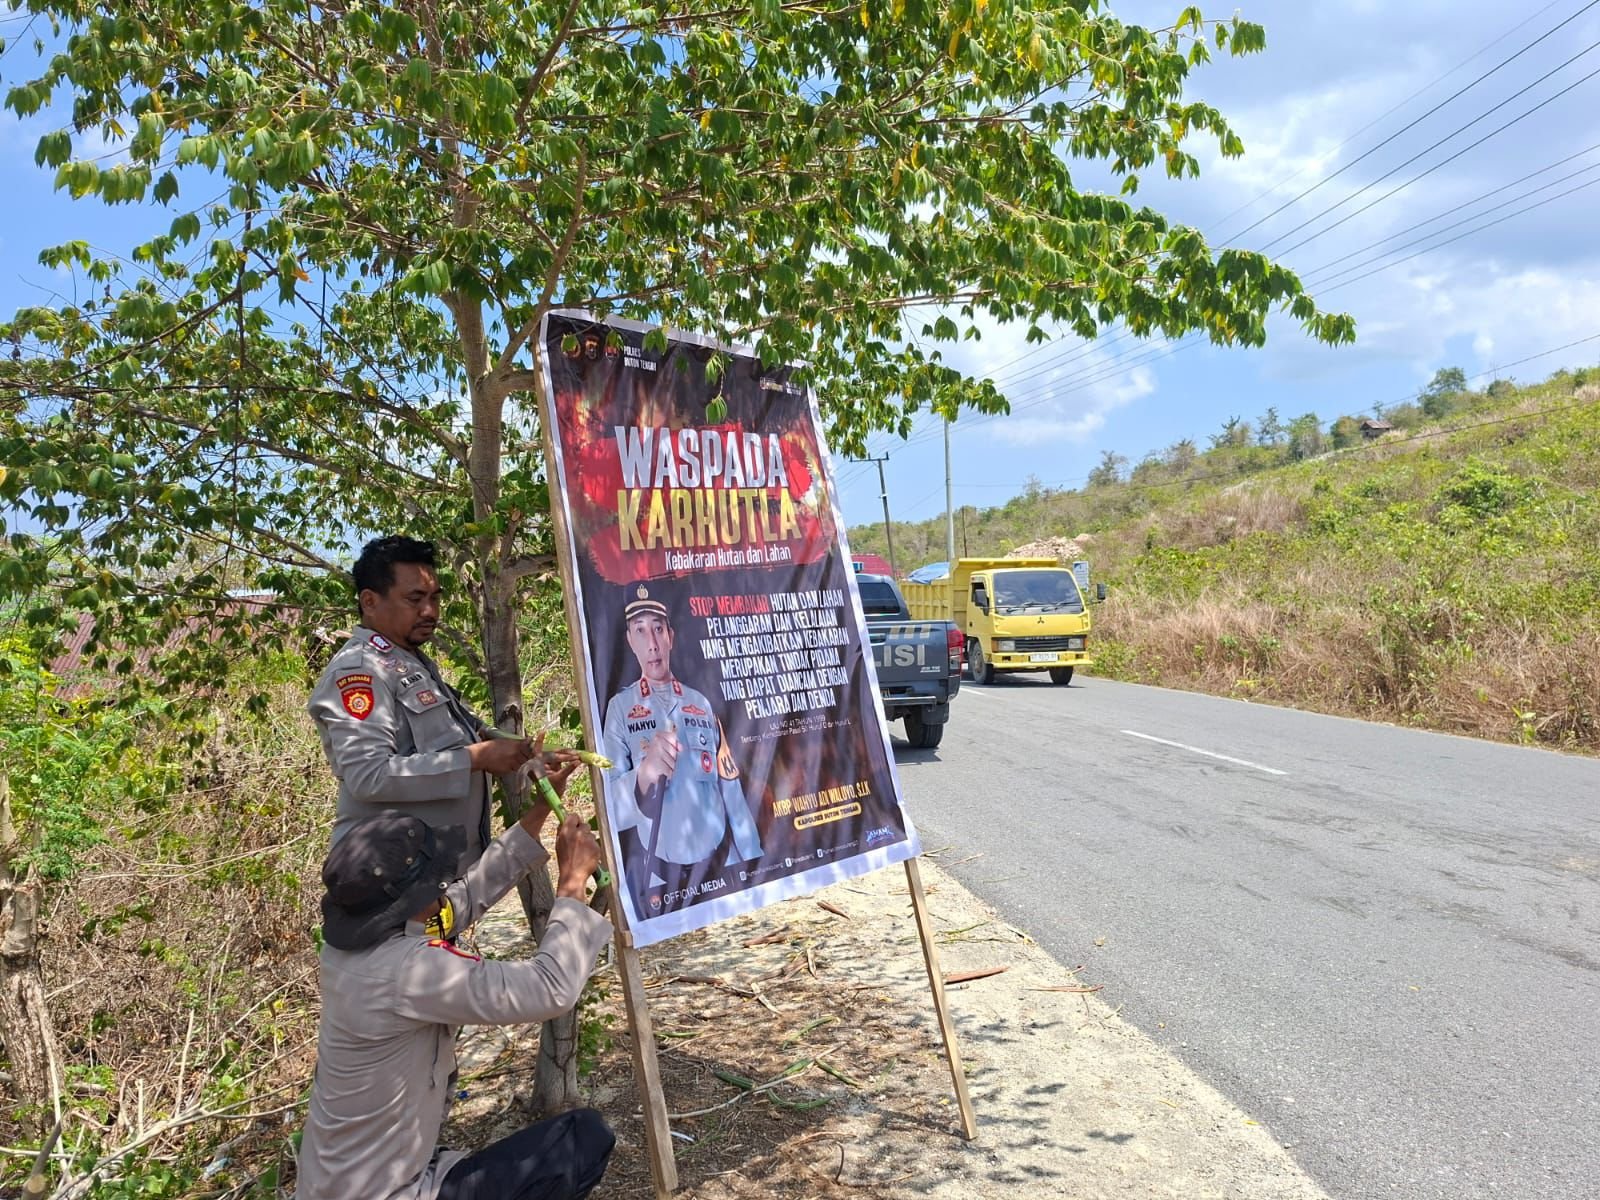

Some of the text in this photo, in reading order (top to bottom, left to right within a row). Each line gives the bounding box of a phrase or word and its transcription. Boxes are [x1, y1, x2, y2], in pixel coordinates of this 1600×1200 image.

[614, 426, 789, 488] WASPADA
[617, 488, 802, 550] KARHUTLA
[665, 544, 791, 571] Kebakaran Hutan dan Lahan
[689, 589, 844, 616] STOP MEMBAKAR HUTAN DAN LAHAN
[706, 608, 838, 637] PELANGGARAN DAN KELALAIAN
[700, 627, 850, 659] YANG MENGAKIBATKAN KEBAKARAN
[720, 647, 840, 679] MERUPAKAN TINDAK PIDANA
[720, 666, 848, 701] YANG DAPAT DIANCAM DENGAN
[745, 688, 836, 719] PENJARA DAN DENDA
[628, 719, 656, 734] WAHYU
[684, 718, 712, 730] POLRI
[663, 877, 727, 905] OFFICIAL MEDIA
